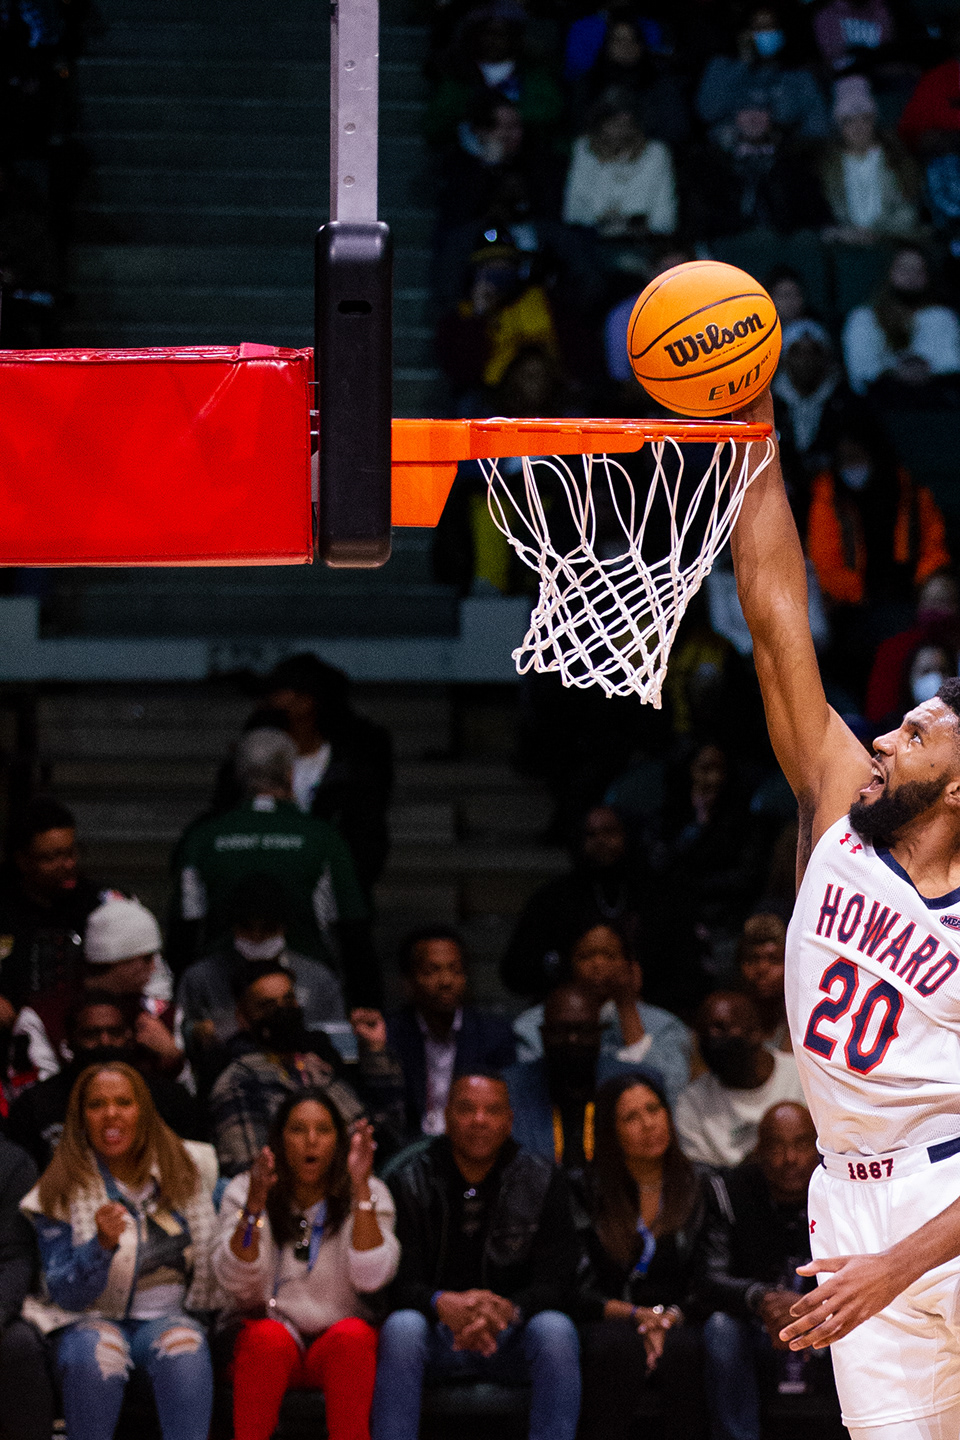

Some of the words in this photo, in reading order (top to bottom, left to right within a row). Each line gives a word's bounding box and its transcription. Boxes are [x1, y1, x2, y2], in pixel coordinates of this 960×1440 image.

[663, 312, 766, 368] Wilson
[815, 883, 960, 998] HOWARD
[803, 956, 904, 1076] 20
[847, 1157, 894, 1180] 1867
